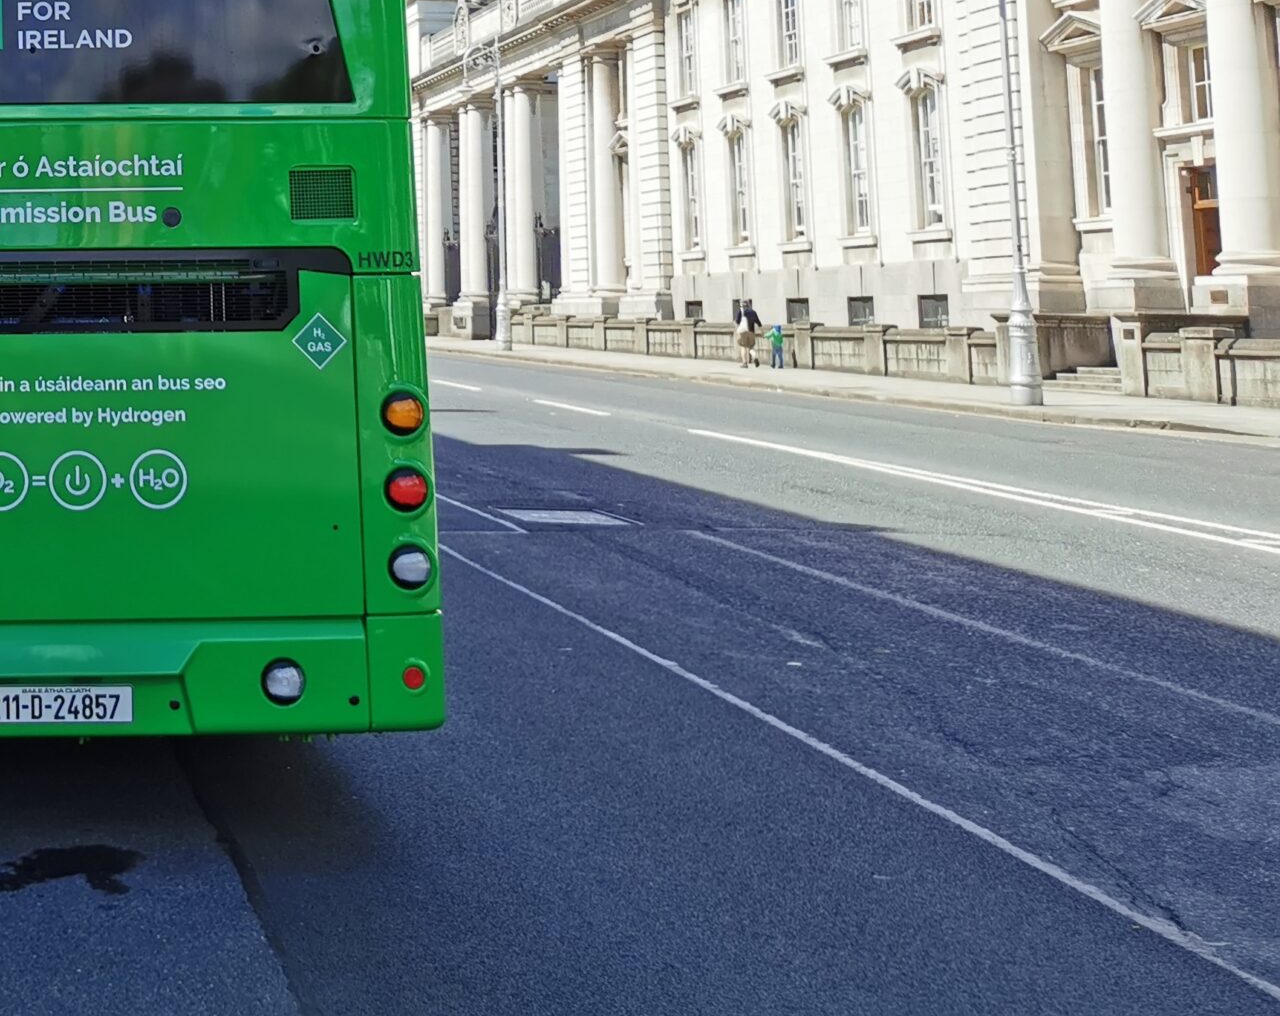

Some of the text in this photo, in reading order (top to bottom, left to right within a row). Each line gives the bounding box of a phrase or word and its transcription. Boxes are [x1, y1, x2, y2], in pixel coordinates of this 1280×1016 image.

[17, 1, 71, 21] FOR
[17, 29, 133, 50] IRELAND
[12, 155, 29, 178] ó
[35, 153, 183, 178] Astaíochtaí
[108, 201, 157, 223] Bus
[359, 252, 413, 268] HWD3
[307, 341, 332, 352] GAS
[19, 380, 31, 393] a
[35, 375, 127, 392] úsáideann
[131, 378, 154, 391] an
[157, 374, 191, 391] bus
[194, 377, 226, 390] seo
[71, 407, 94, 428] by
[97, 406, 186, 427] Hydrogen
